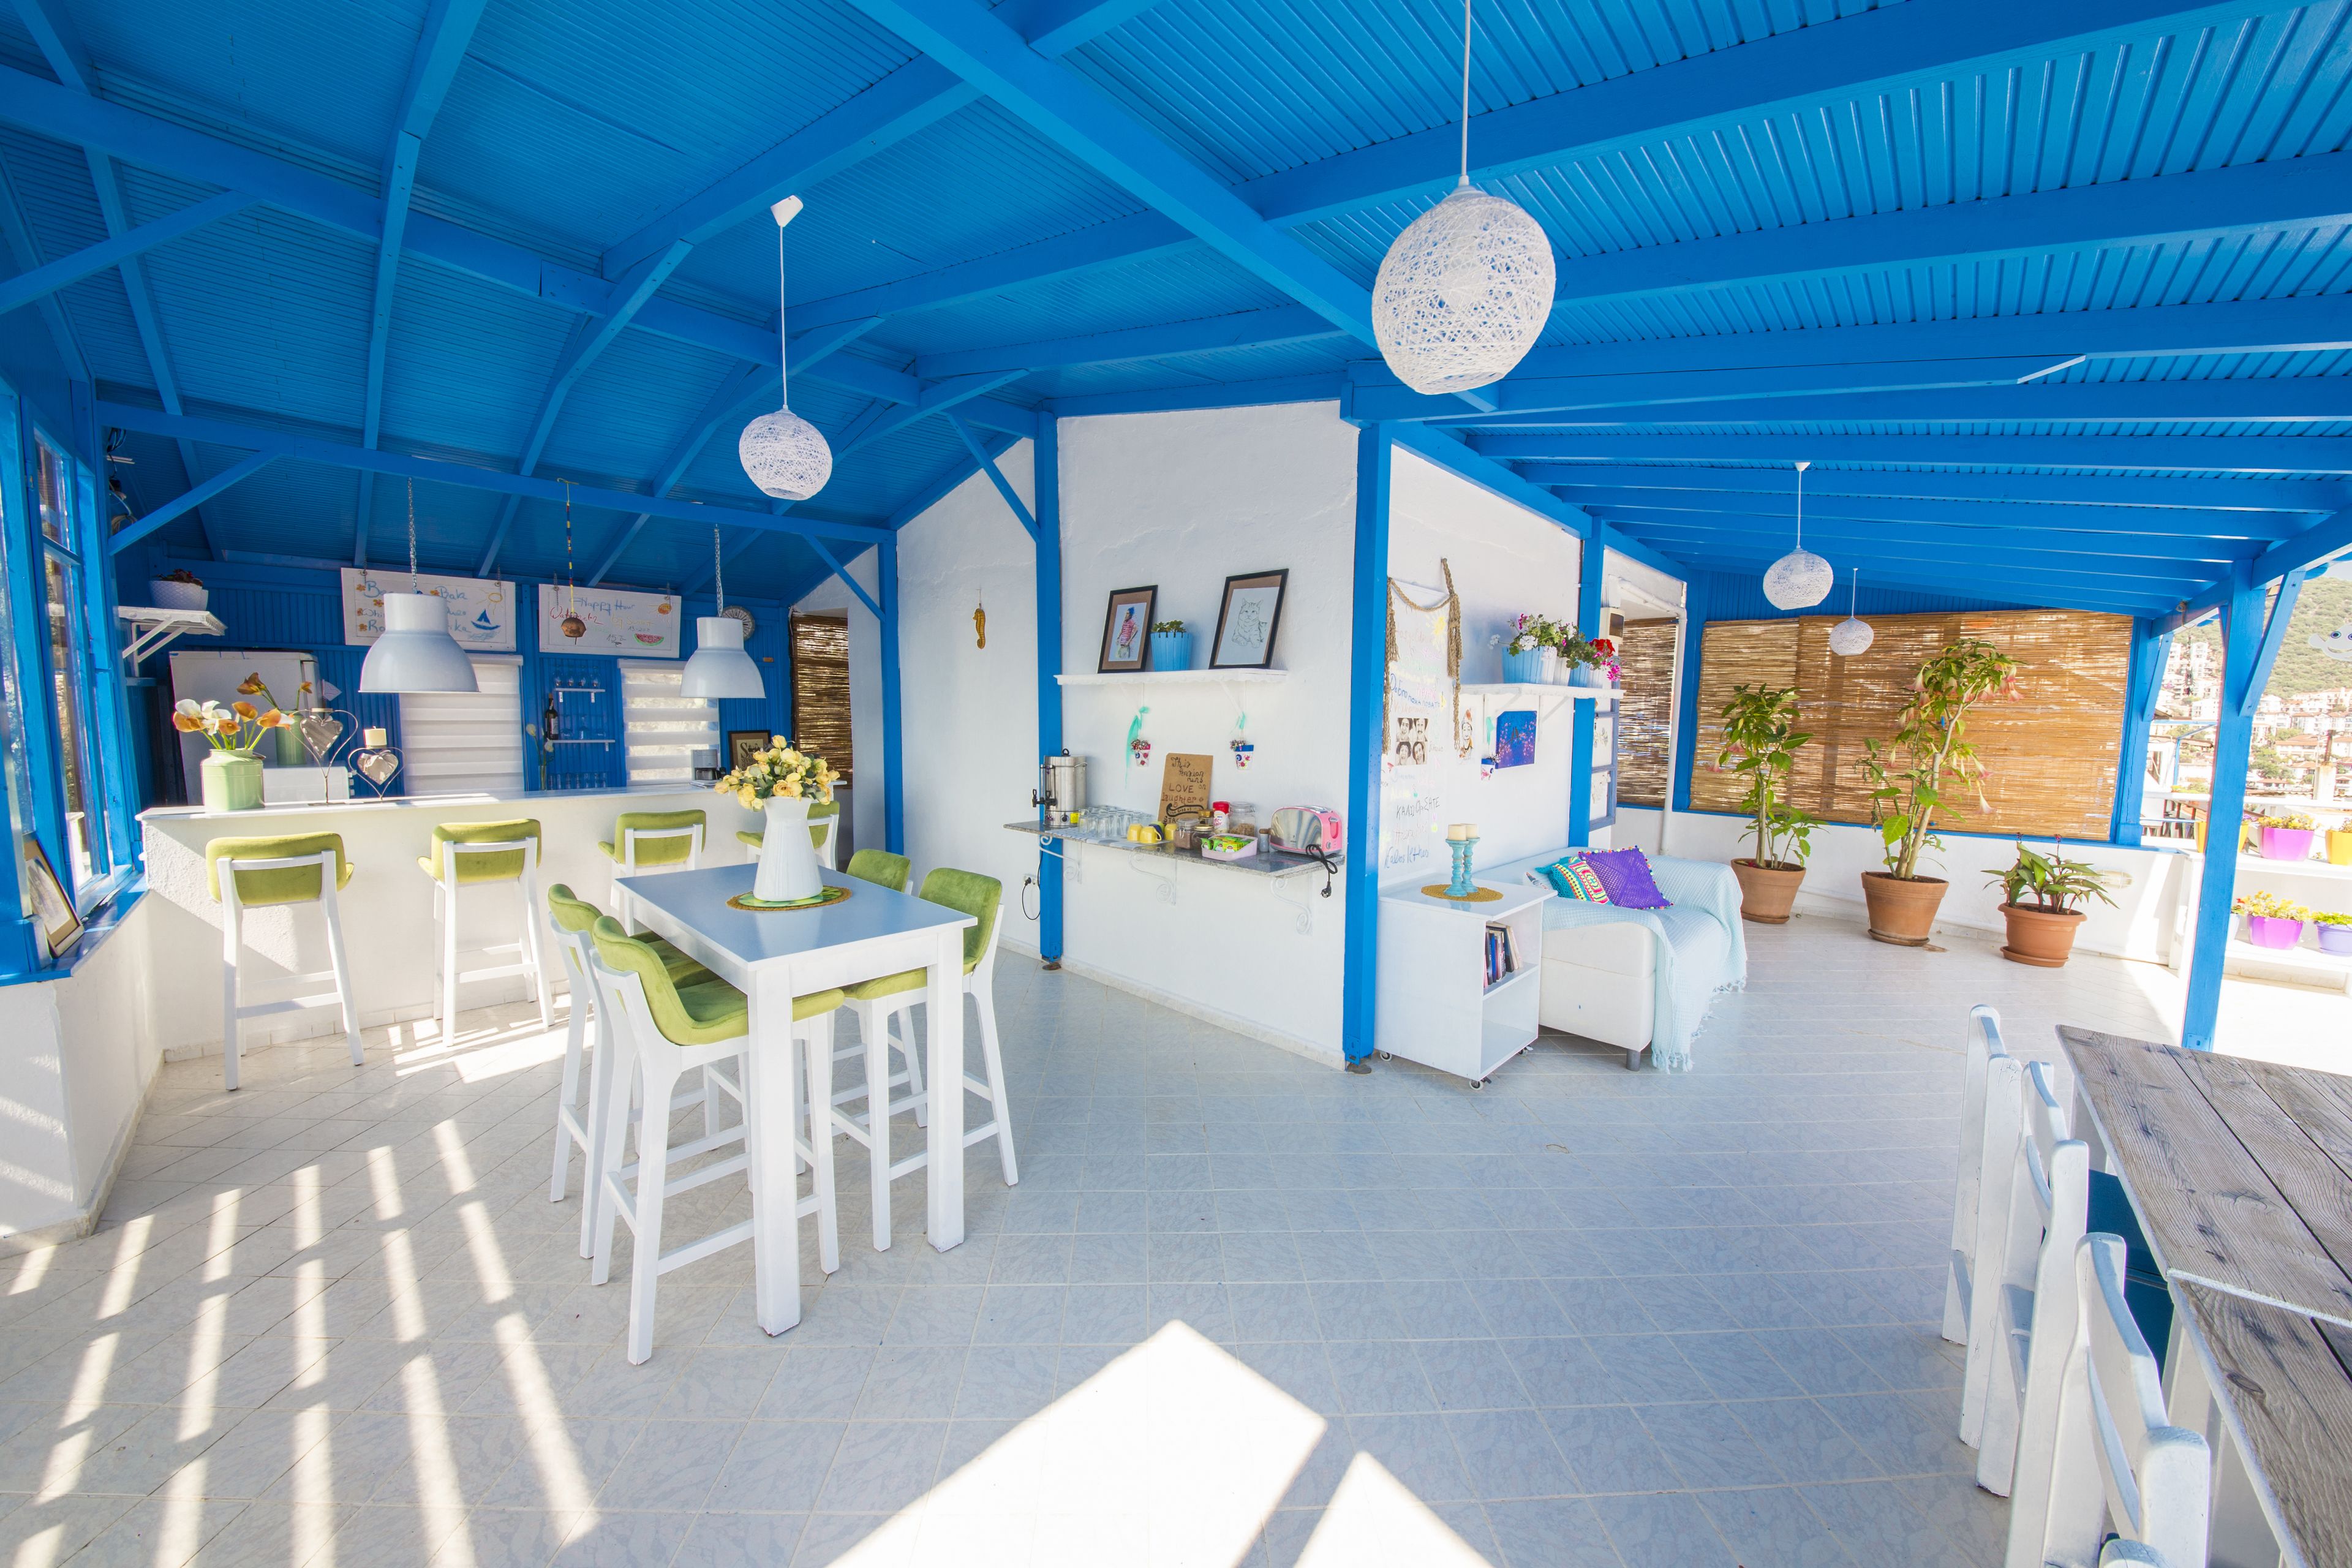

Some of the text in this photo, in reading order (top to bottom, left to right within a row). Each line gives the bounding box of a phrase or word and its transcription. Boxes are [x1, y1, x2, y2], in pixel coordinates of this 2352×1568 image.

[569, 598, 635, 616] Happy Hour
[1170, 757, 1191, 768] This
[1169, 783, 1194, 793] LOVE
[1161, 793, 1196, 808] laughter
